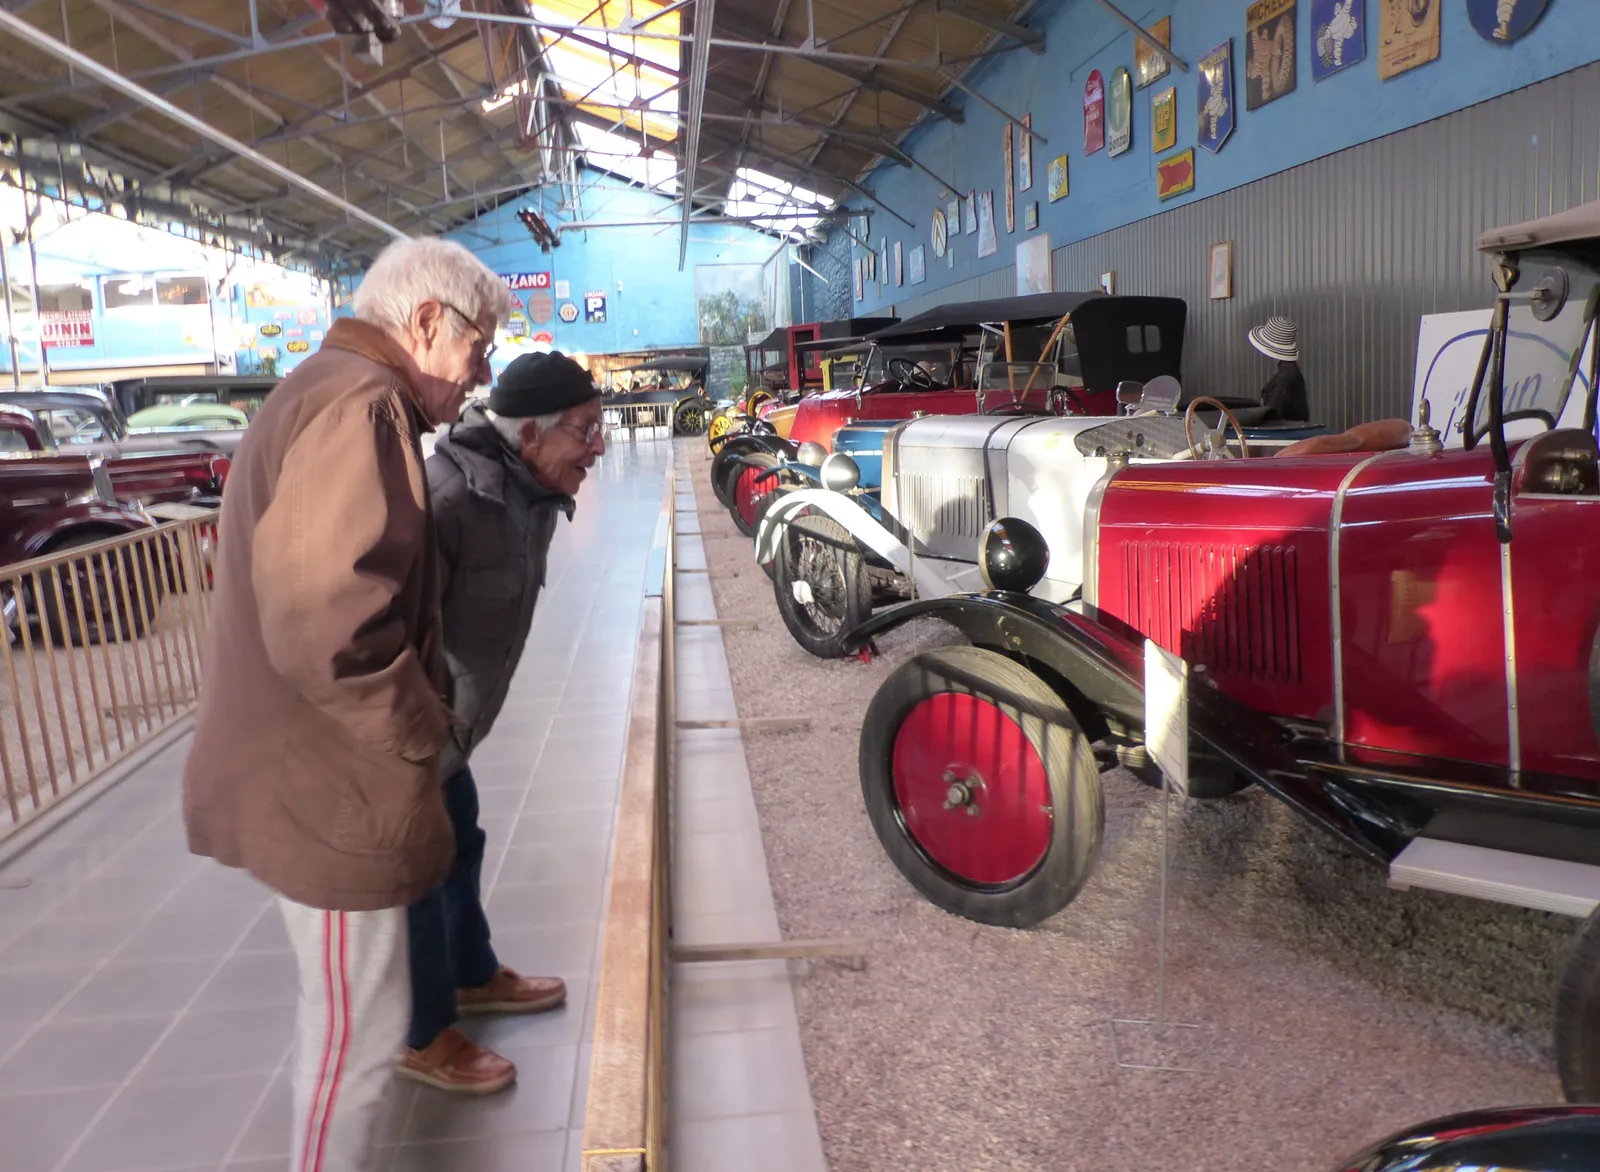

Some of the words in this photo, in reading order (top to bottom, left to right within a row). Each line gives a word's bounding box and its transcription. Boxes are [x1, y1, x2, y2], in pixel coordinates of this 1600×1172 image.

[1248, 0, 1293, 20] MICHEL
[502, 273, 547, 289] NZANO
[588, 298, 603, 312] P
